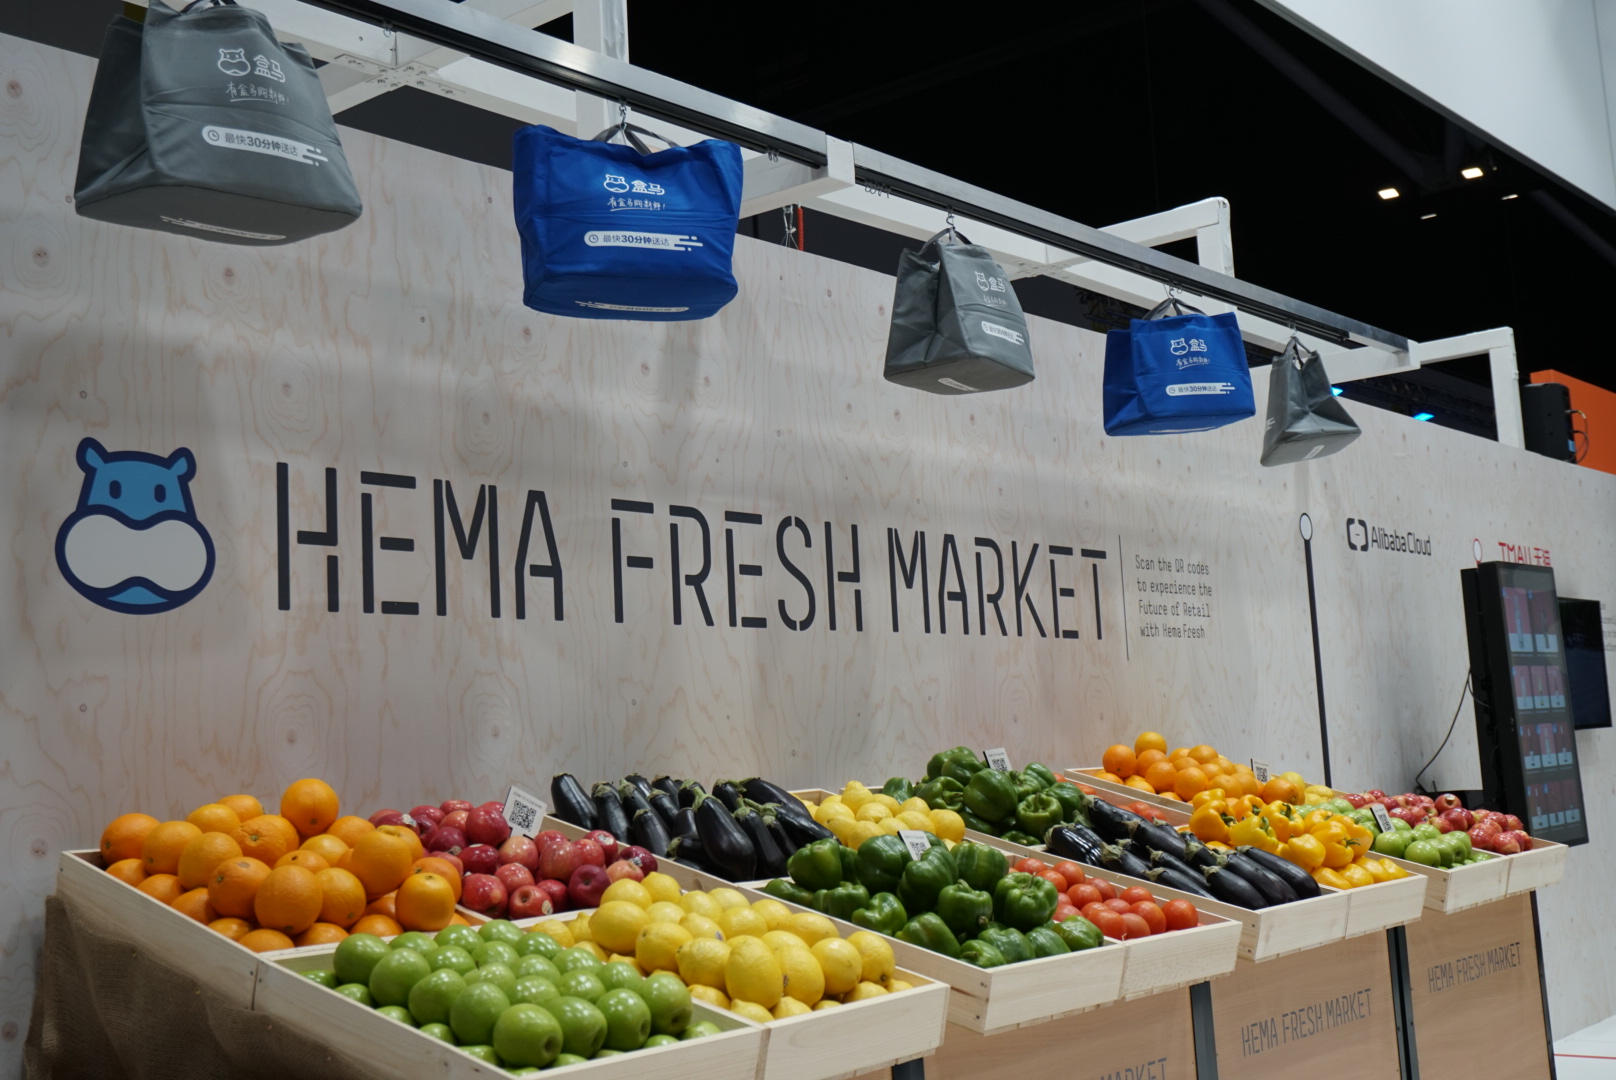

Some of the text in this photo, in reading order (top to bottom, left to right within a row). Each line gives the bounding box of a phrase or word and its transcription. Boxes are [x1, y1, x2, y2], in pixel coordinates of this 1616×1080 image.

[253, 54, 286, 83] 盒马
[224, 131, 299, 156] 最快30分钟送达
[631, 179, 665, 195] 盒马
[603, 234, 670, 246] 最快30分钟送达
[1189, 338, 1208, 352] 盒马
[276, 462, 1107, 640] HEMA FRESH MARKET
[1135, 554, 1209, 575] Scan the QR codes
[1137, 577, 1212, 597] to experience the
[1139, 599, 1211, 617] Future of Retail
[1140, 622, 1160, 637] with
[1428, 942, 1520, 993] HEMA FRESH MARKET
[1241, 988, 1371, 1057] HEMA FRESH MARKET
